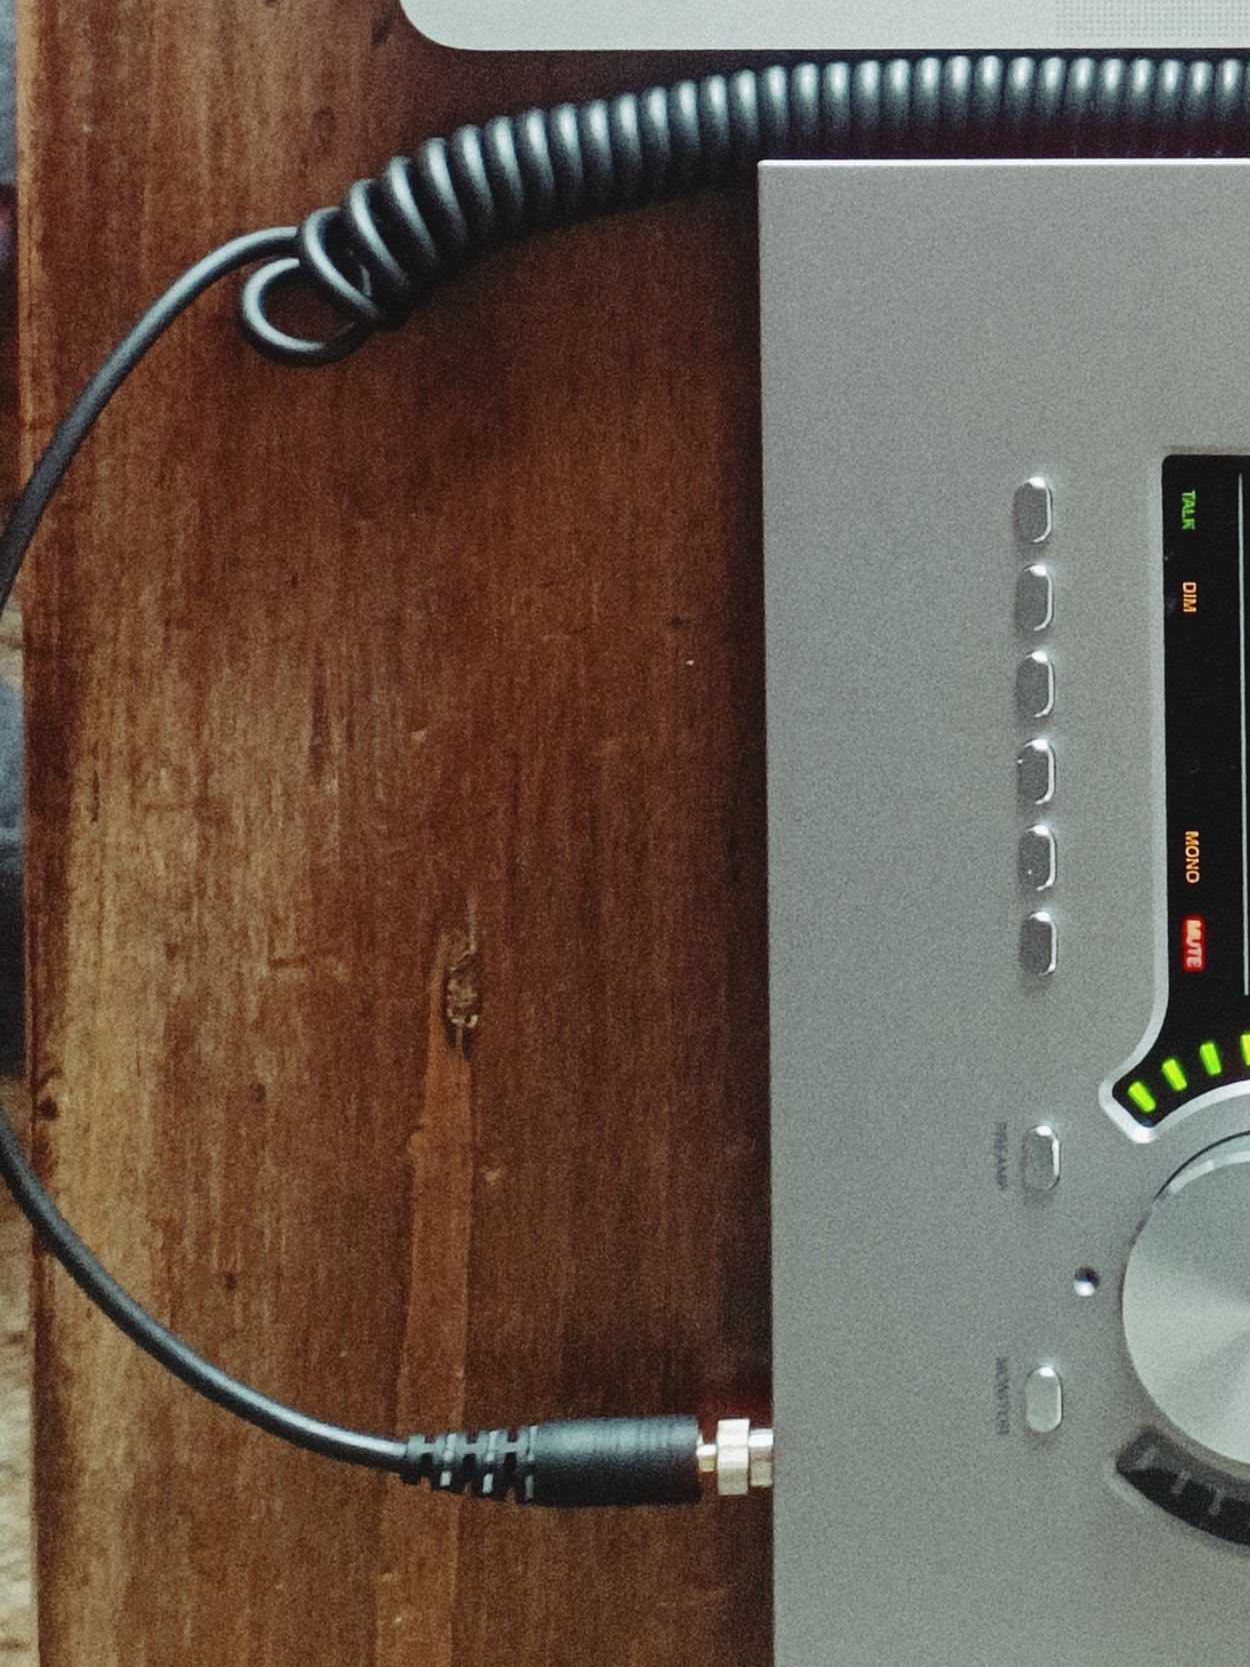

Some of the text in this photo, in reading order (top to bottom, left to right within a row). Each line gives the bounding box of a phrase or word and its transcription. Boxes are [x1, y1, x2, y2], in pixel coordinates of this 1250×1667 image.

[1181, 489, 1197, 530] TALK
[1182, 581, 1197, 613] DIM
[1184, 830, 1200, 884] MONO
[1186, 920, 1202, 967] MUTE
